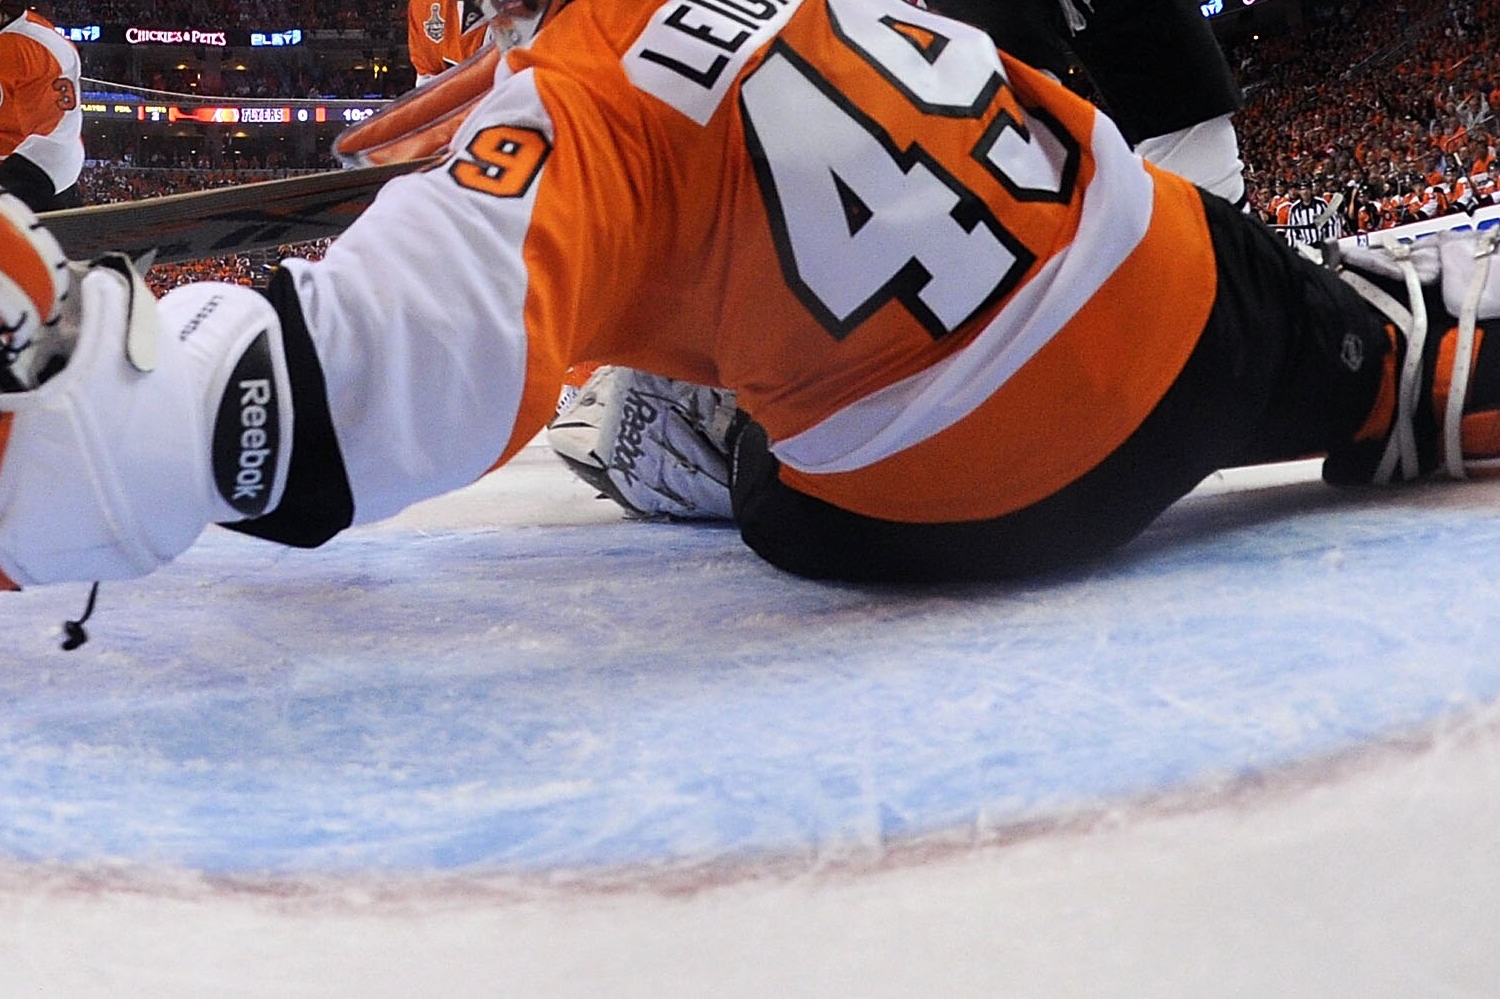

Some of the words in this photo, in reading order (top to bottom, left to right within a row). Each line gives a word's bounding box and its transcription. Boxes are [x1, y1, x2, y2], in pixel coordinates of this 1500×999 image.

[125, 26, 182, 45] CHICKIE'S
[243, 109, 282, 121] FLYERS
[297, 108, 308, 122] 0
[343, 108, 374, 121] 10:3
[448, 124, 553, 199] 9
[232, 379, 272, 500] Reebok
